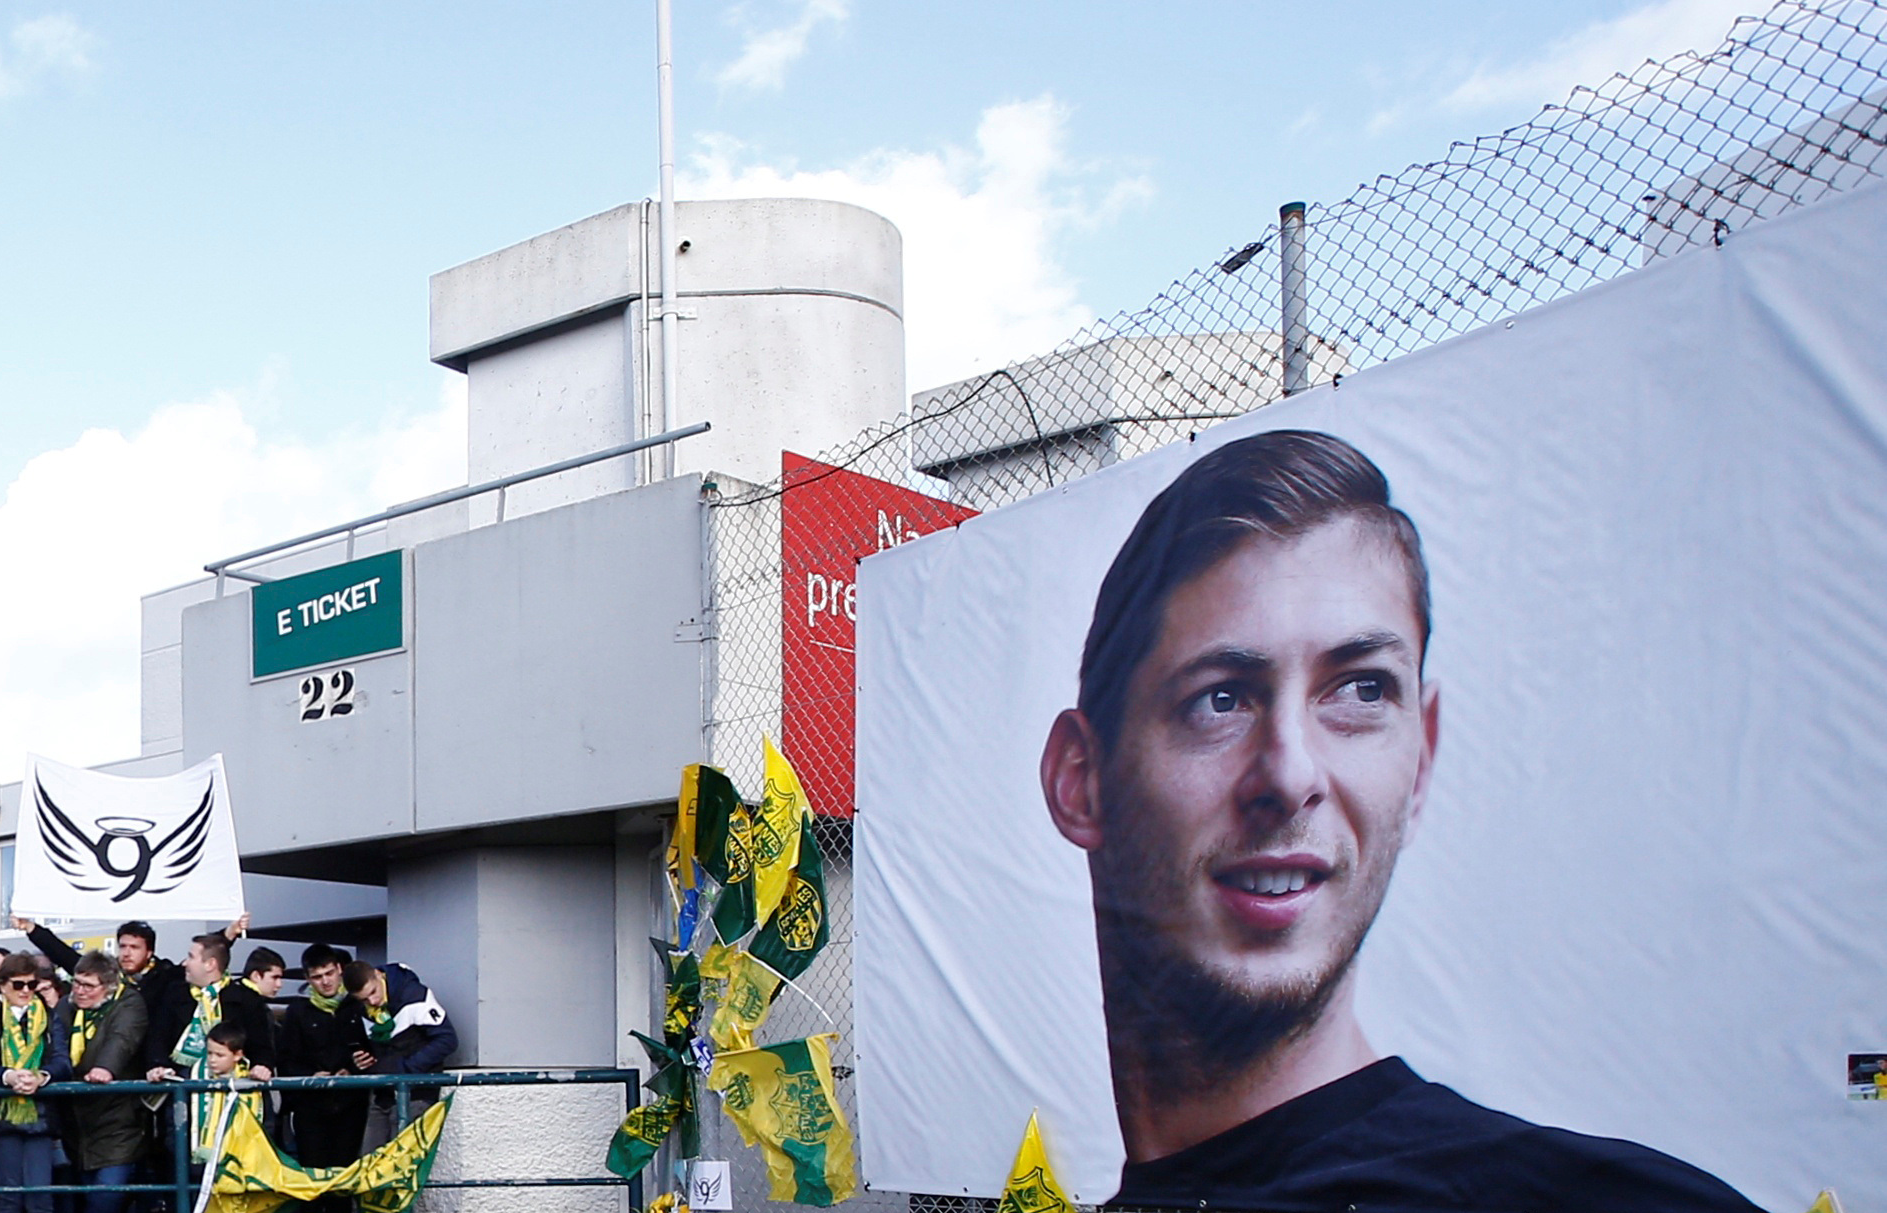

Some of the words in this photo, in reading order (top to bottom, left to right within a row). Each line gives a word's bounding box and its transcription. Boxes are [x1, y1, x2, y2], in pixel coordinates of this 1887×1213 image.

[877, 509, 920, 552] N
[277, 608, 293, 636] E
[297, 577, 381, 628] TICKET
[301, 670, 354, 722] 22
[95, 830, 152, 903] 9
[428, 1007, 441, 1022] R
